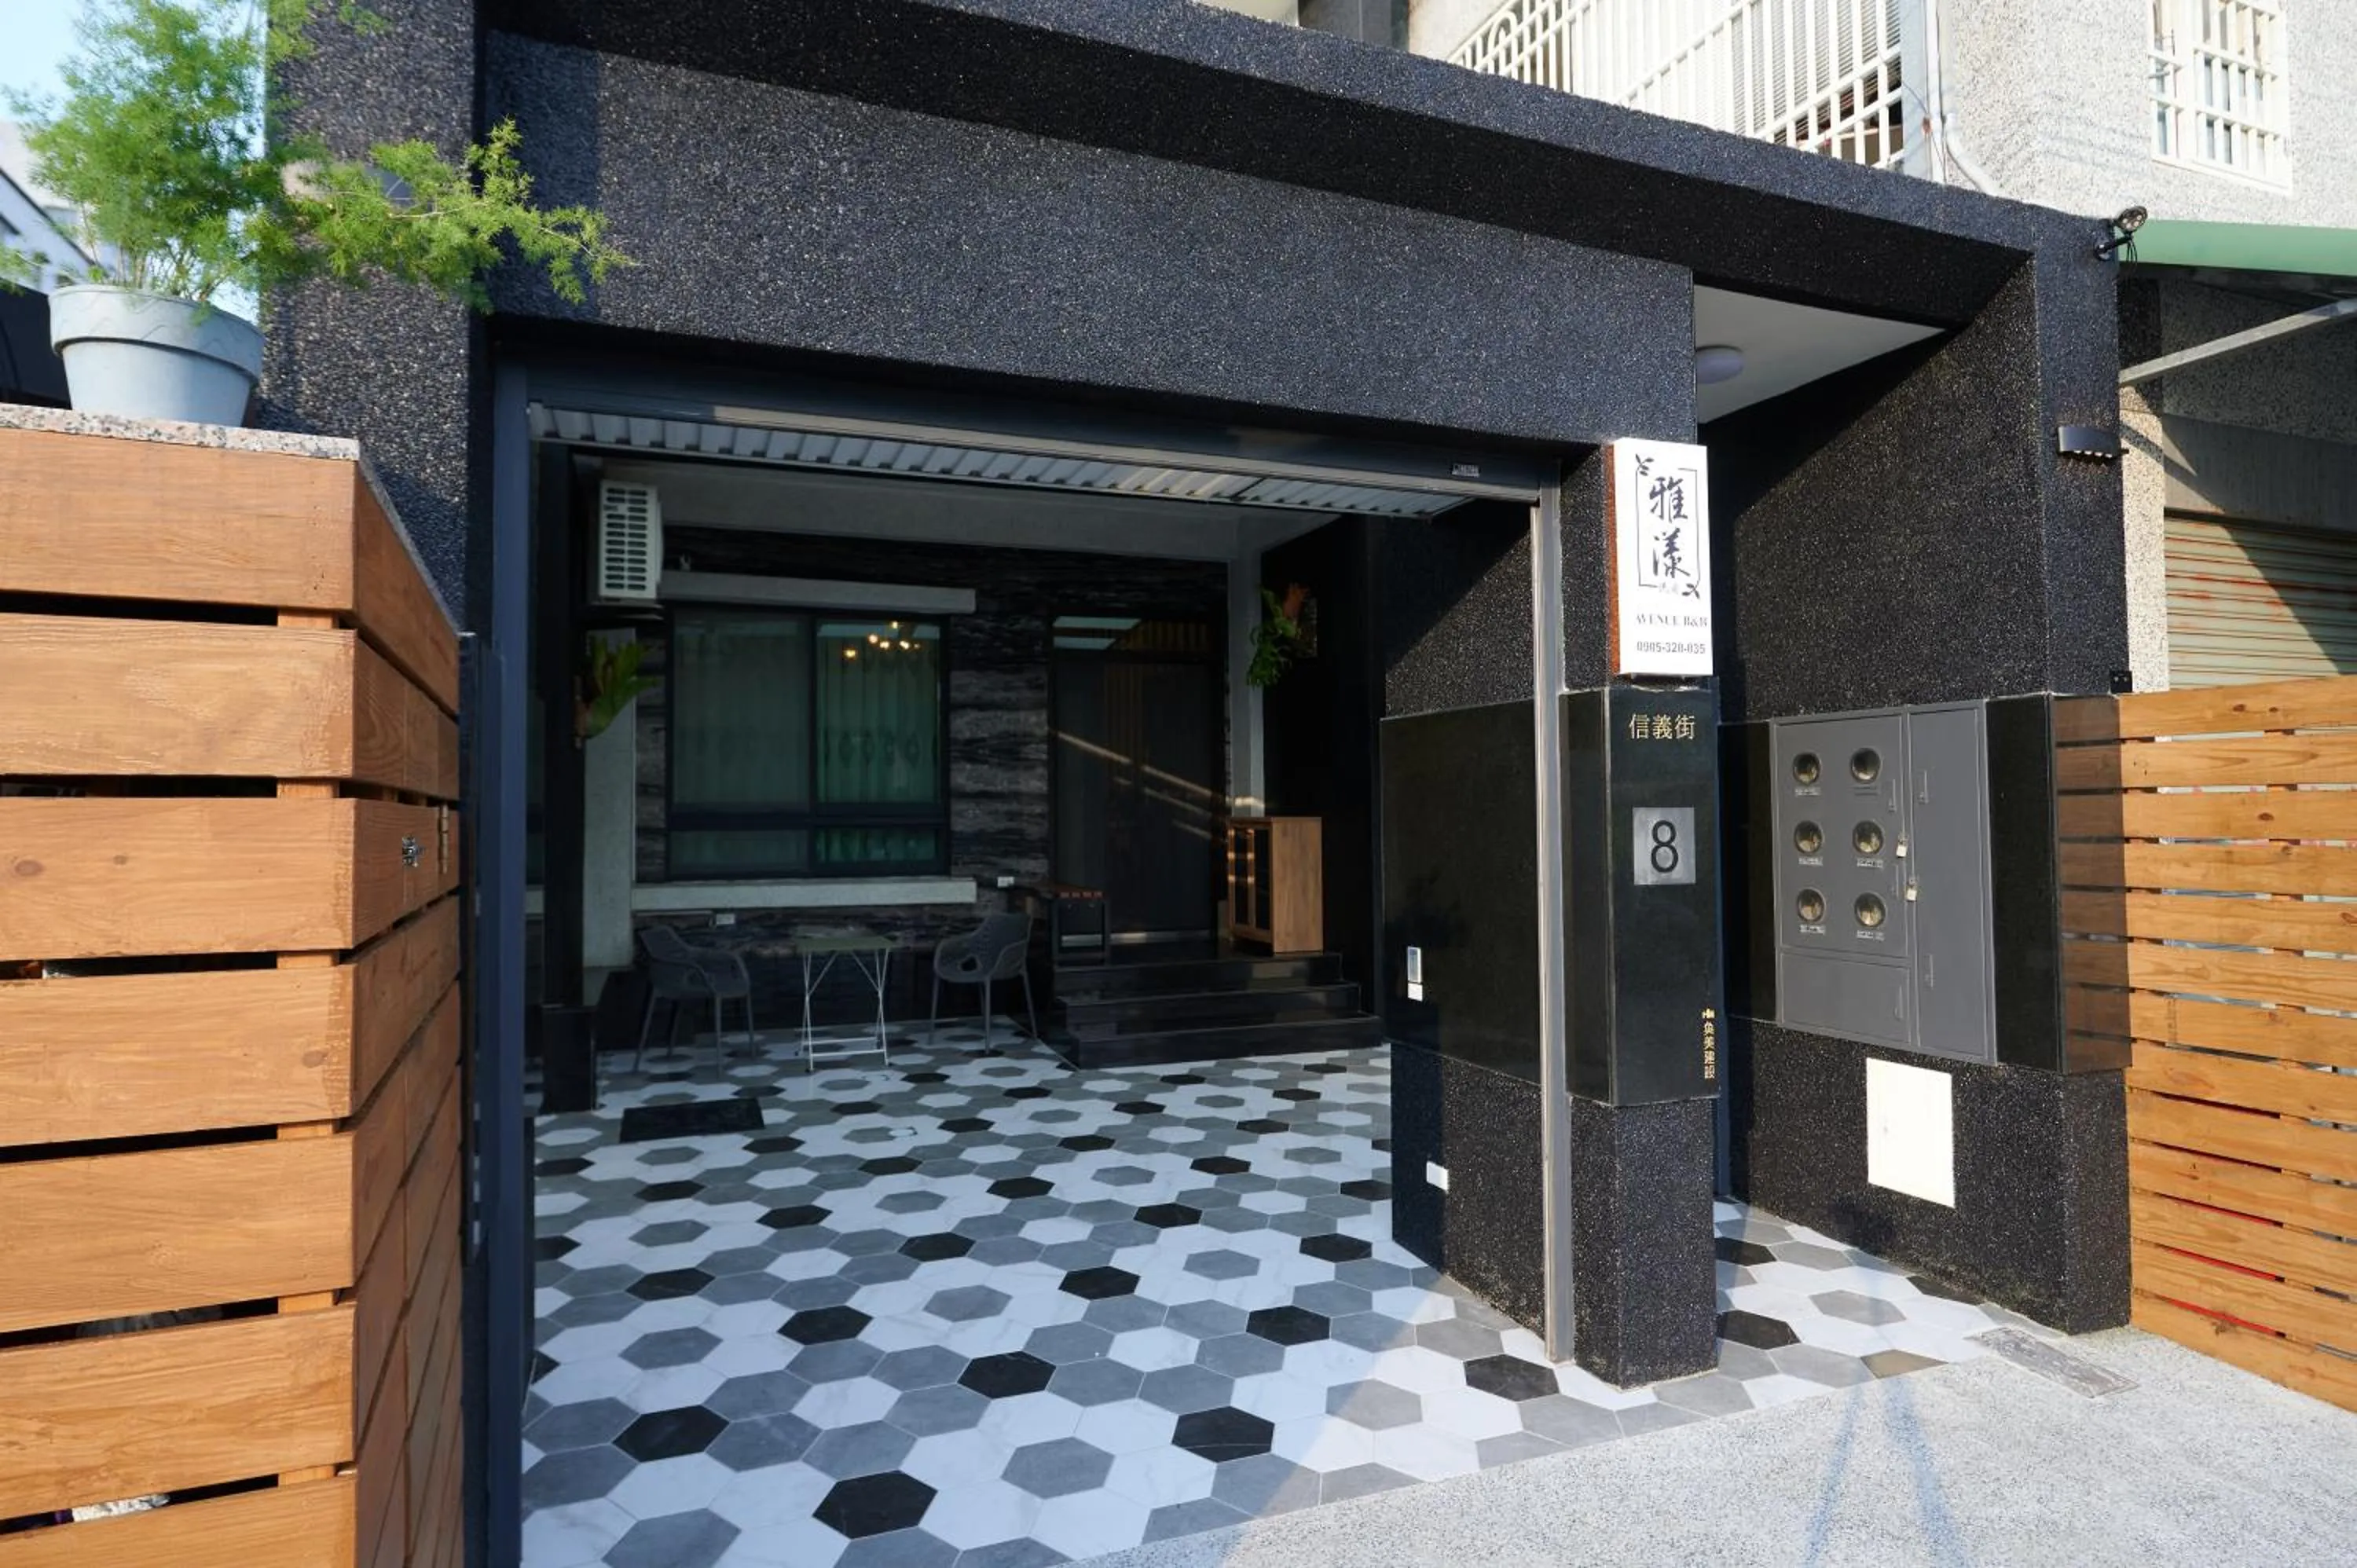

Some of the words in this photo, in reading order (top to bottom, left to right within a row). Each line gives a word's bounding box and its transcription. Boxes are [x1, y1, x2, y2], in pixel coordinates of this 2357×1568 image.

[1629, 713, 1695, 740] 信義街
[1651, 819, 1679, 874] 8
